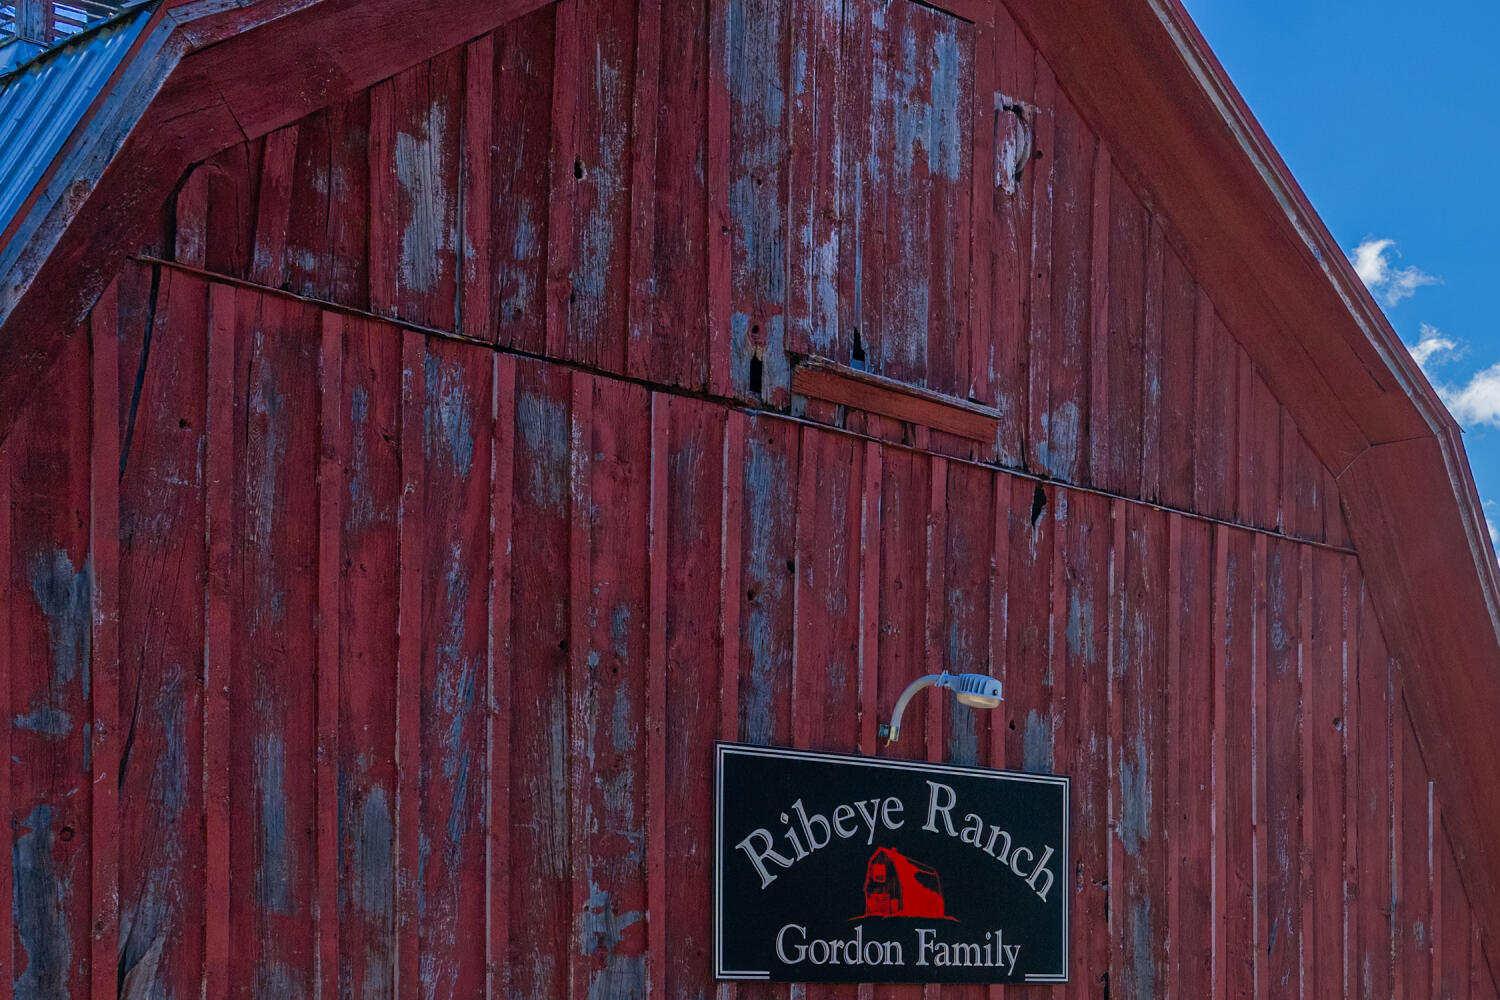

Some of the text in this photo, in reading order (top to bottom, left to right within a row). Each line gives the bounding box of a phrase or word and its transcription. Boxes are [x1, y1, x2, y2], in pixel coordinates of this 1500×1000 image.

[735, 780, 1055, 902] Ribeye Ranch
[775, 923, 1021, 976] Gordon Family
